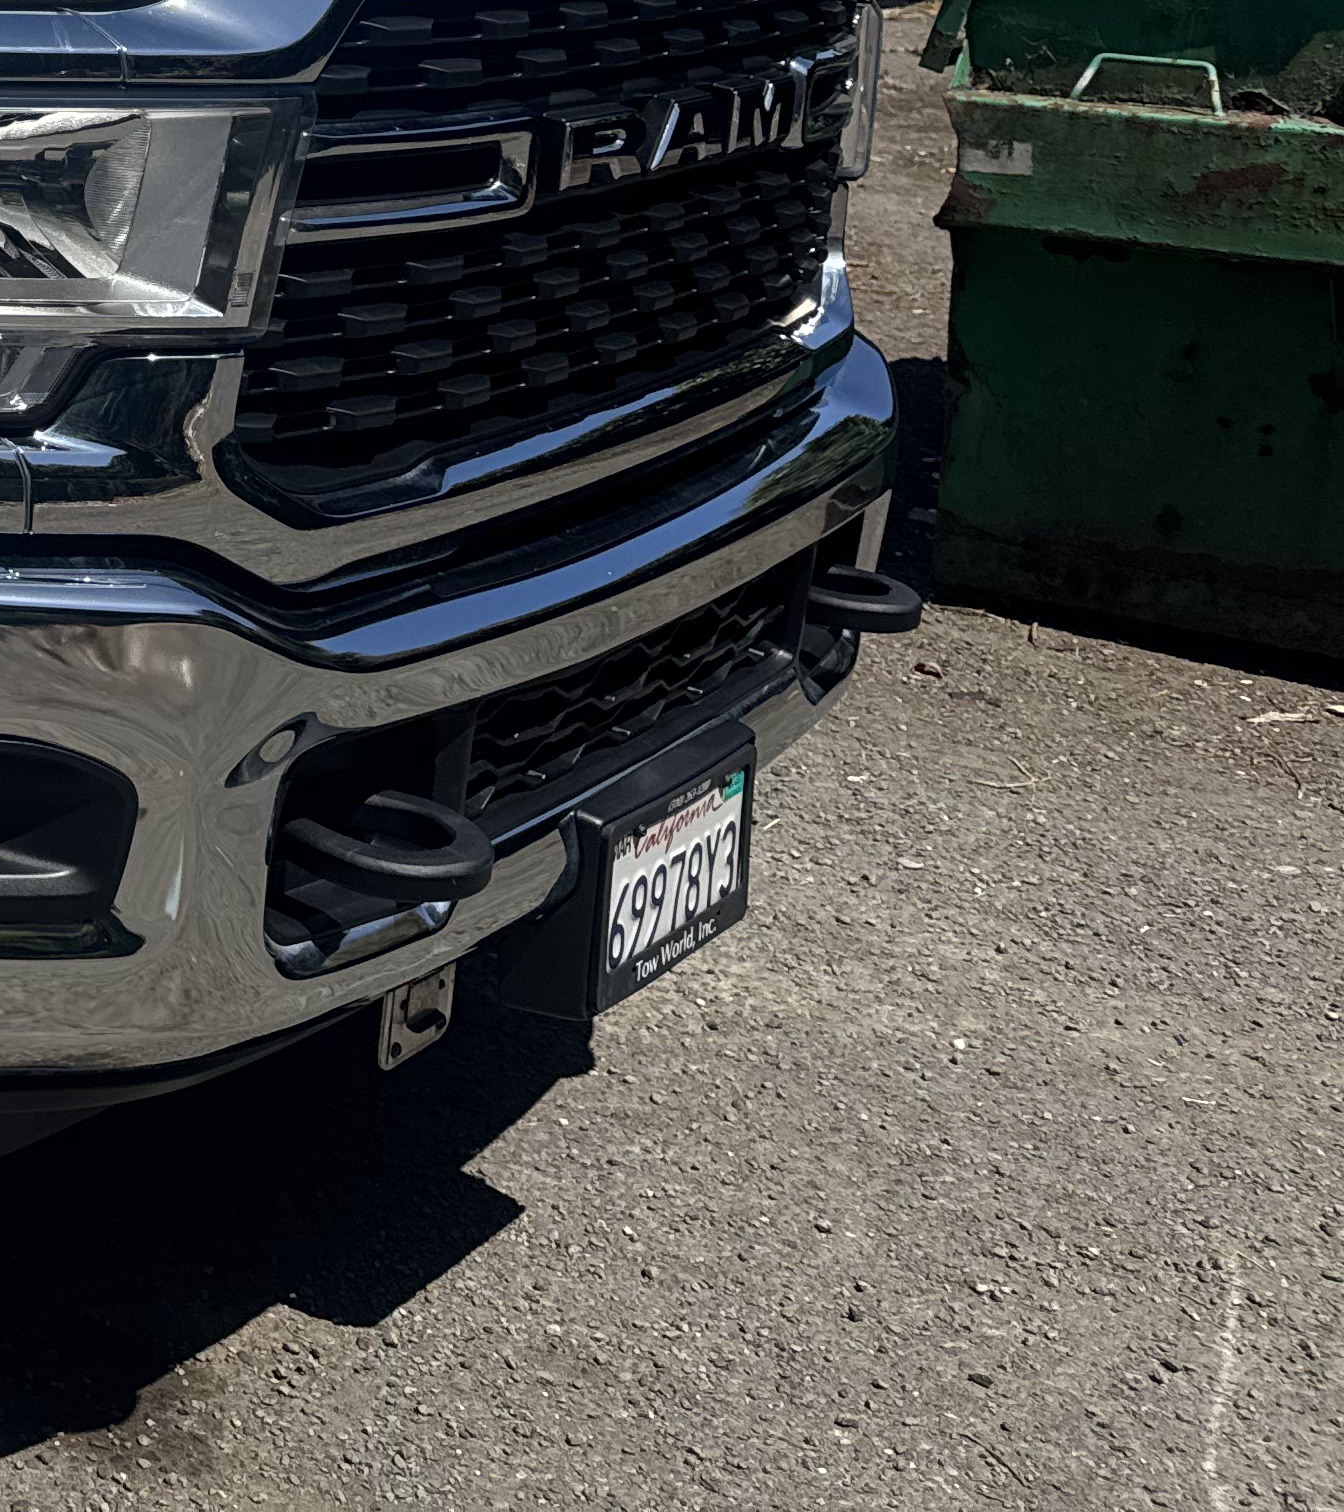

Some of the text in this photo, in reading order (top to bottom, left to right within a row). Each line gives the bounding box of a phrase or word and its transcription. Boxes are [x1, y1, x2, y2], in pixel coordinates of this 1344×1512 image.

[556, 60, 811, 192] RAM
[632, 793, 724, 861] California
[608, 820, 737, 971] 69978Y3
[635, 918, 717, 982] Tow World, Inc.
